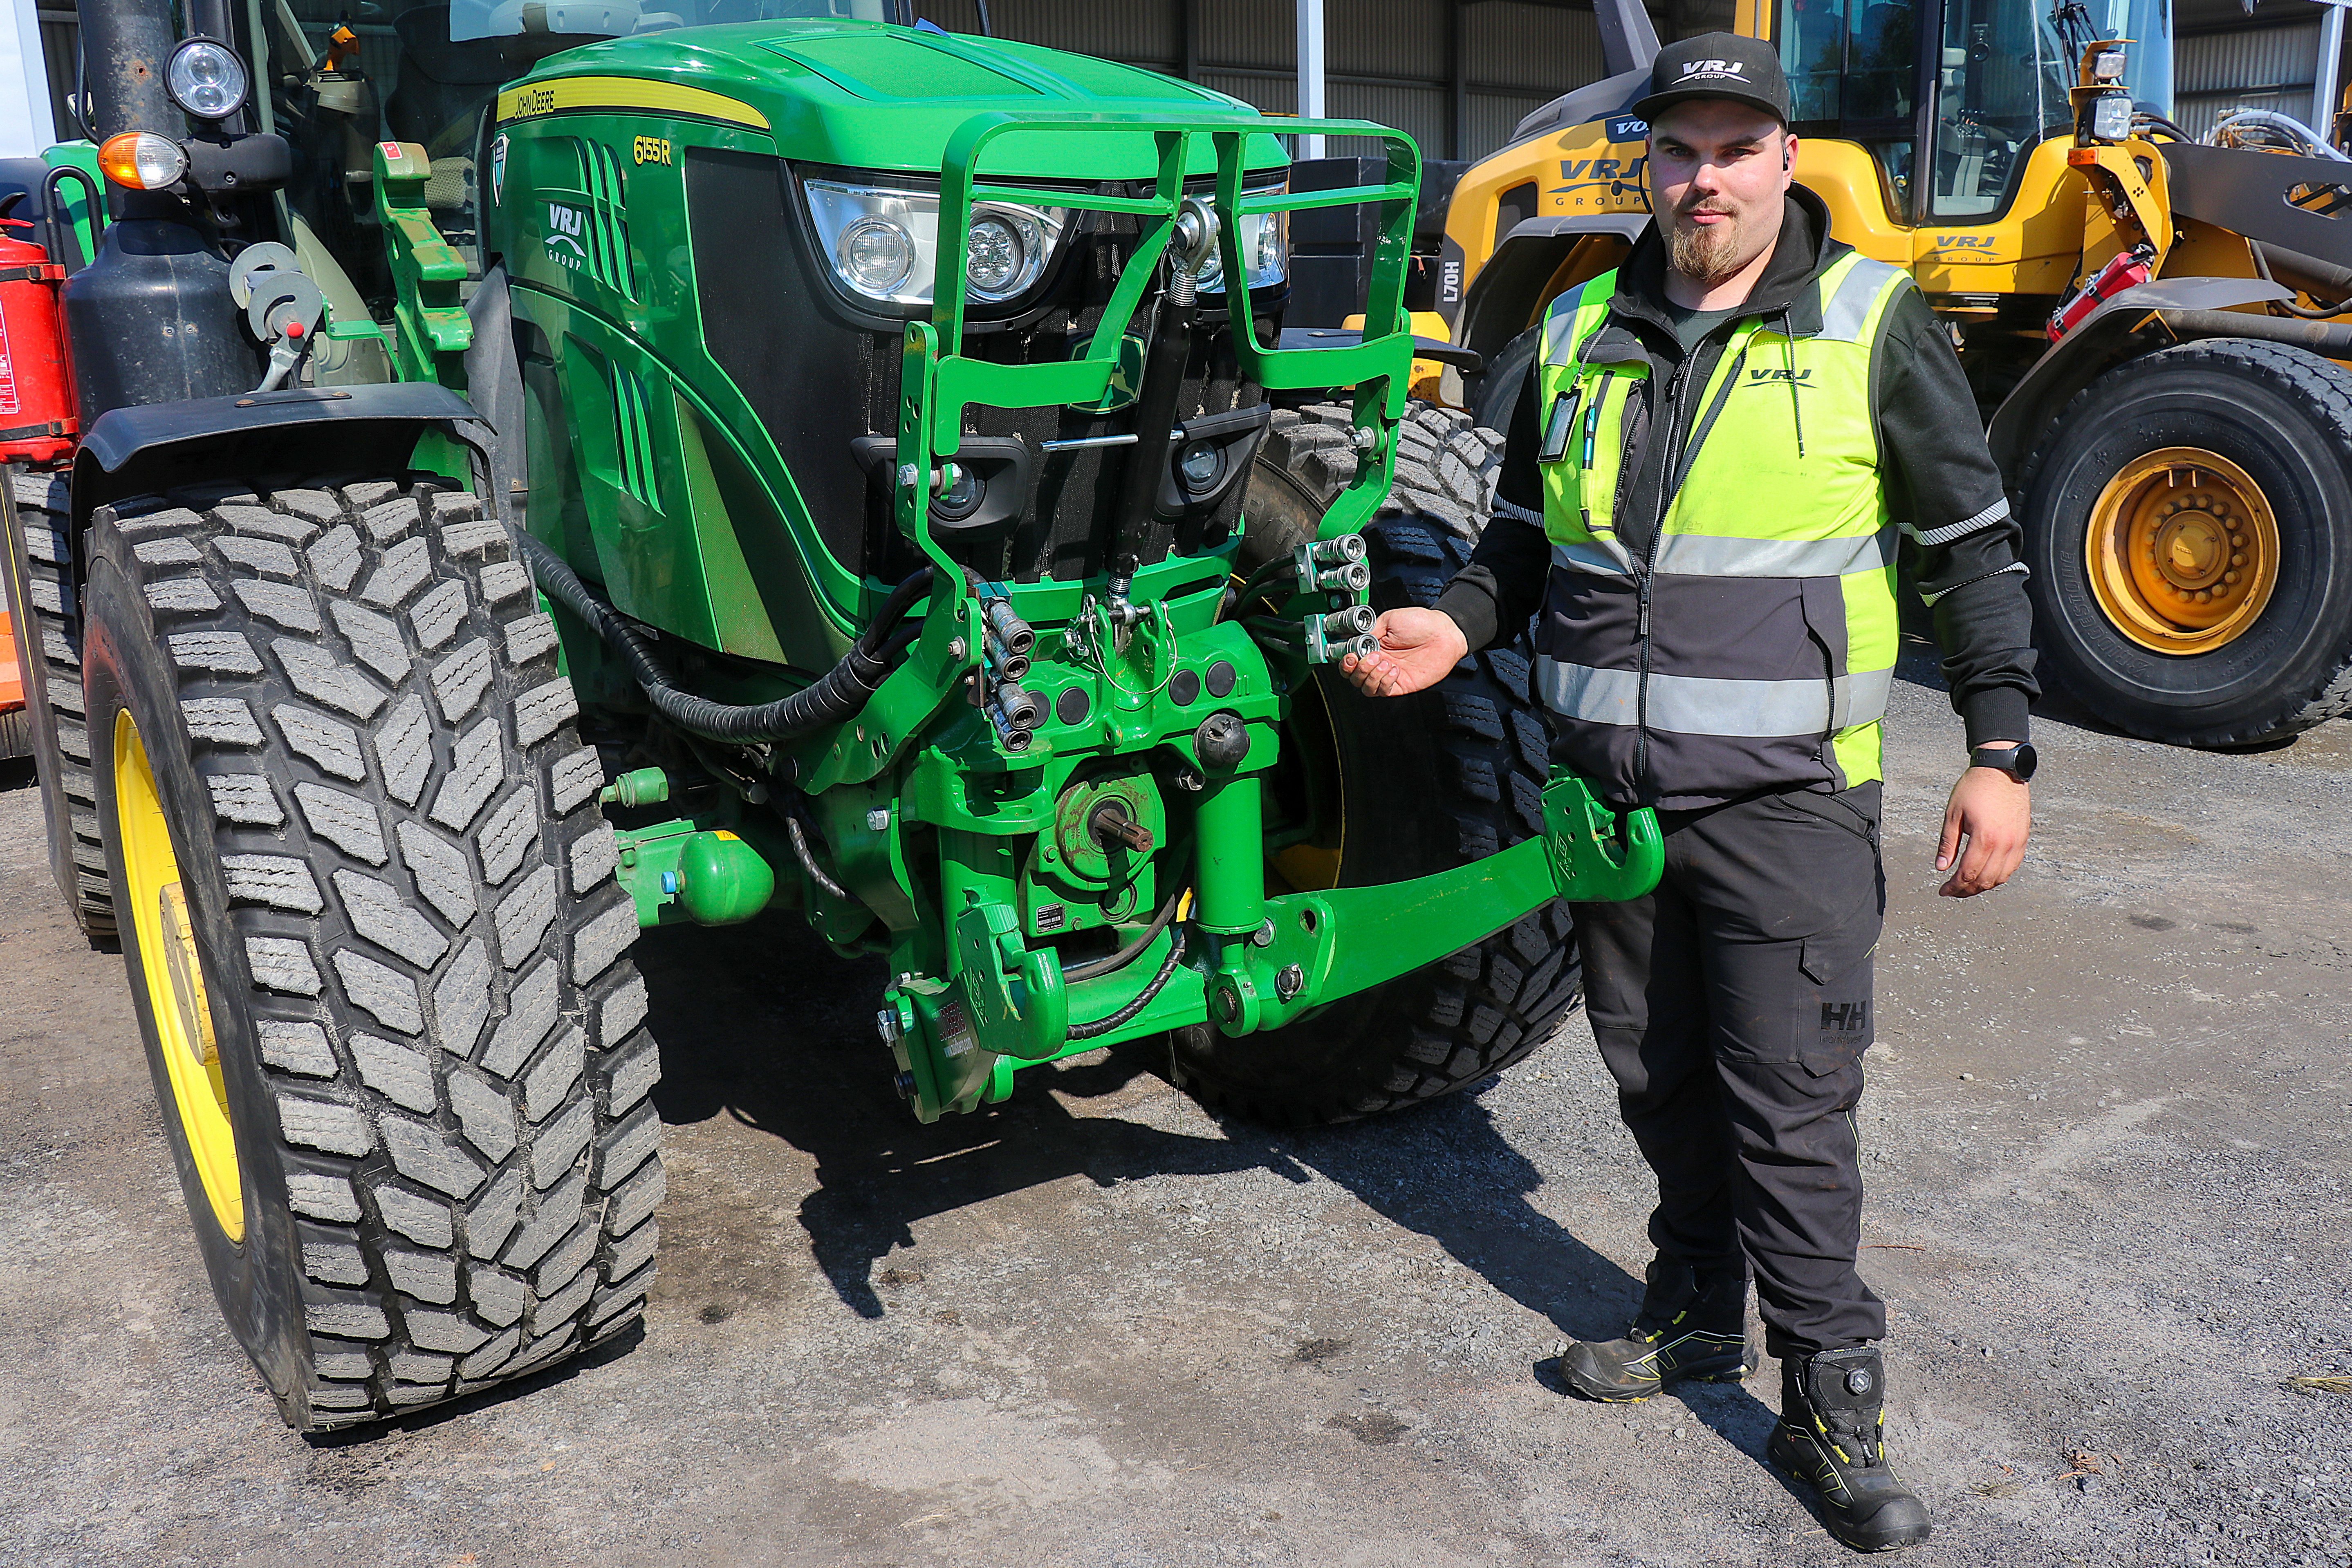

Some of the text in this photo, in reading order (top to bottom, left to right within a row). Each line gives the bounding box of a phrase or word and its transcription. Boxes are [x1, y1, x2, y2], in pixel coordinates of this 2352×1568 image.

[1682, 60, 1744, 75] VRJ
[515, 89, 554, 116] JOHN DEERE
[1560, 158, 1642, 179] VRJ
[1555, 197, 1641, 206] GROUP
[549, 203, 582, 236] VRJ
[1936, 236, 1996, 247] VRJ
[548, 249, 581, 271] GROUP
[1443, 262, 1460, 302] L70H
[1751, 369, 1812, 380] VRJ
[2060, 551, 2154, 678] BRIDGESTONE
